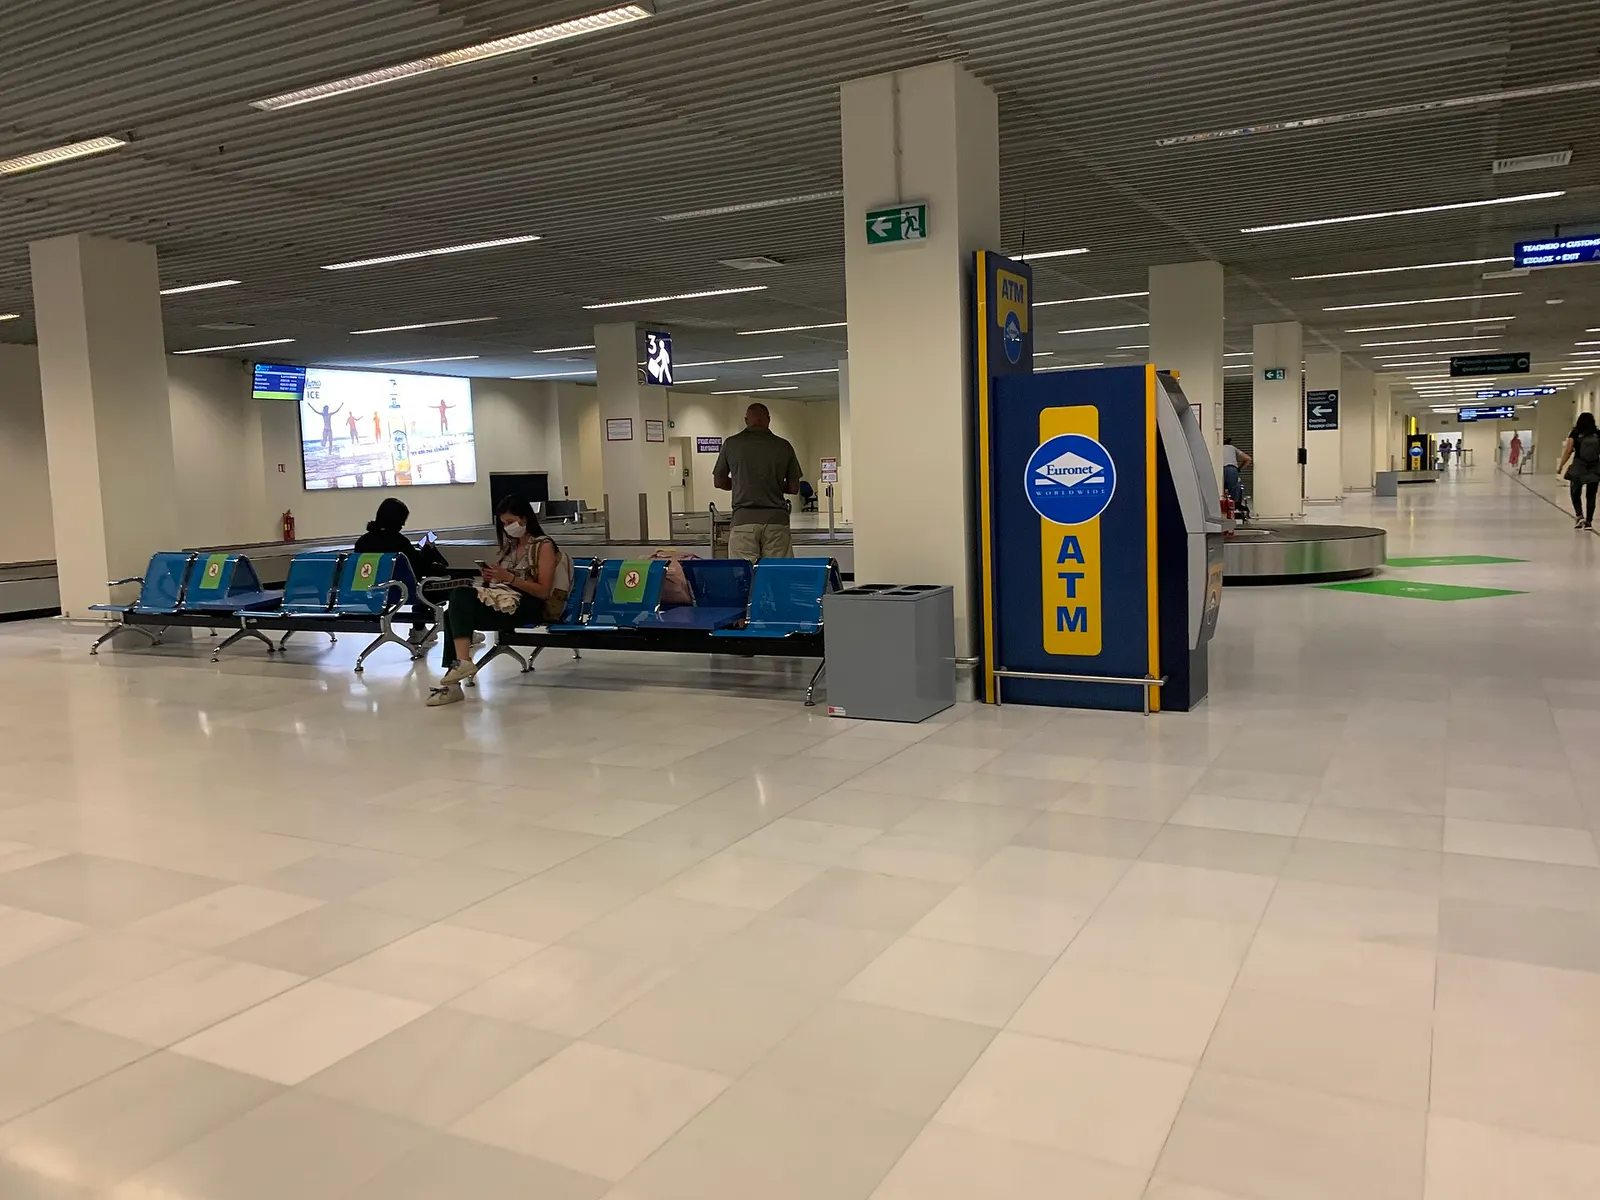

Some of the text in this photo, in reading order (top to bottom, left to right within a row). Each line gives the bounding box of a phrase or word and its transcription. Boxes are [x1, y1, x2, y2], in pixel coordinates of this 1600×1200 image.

[1562, 252, 1580, 261] EXIT
[1002, 279, 1024, 304] ATM
[648, 334, 657, 355] 3
[307, 391, 320, 399] ICE
[1046, 464, 1093, 475] Euronet
[1056, 535, 1088, 632] ATM
